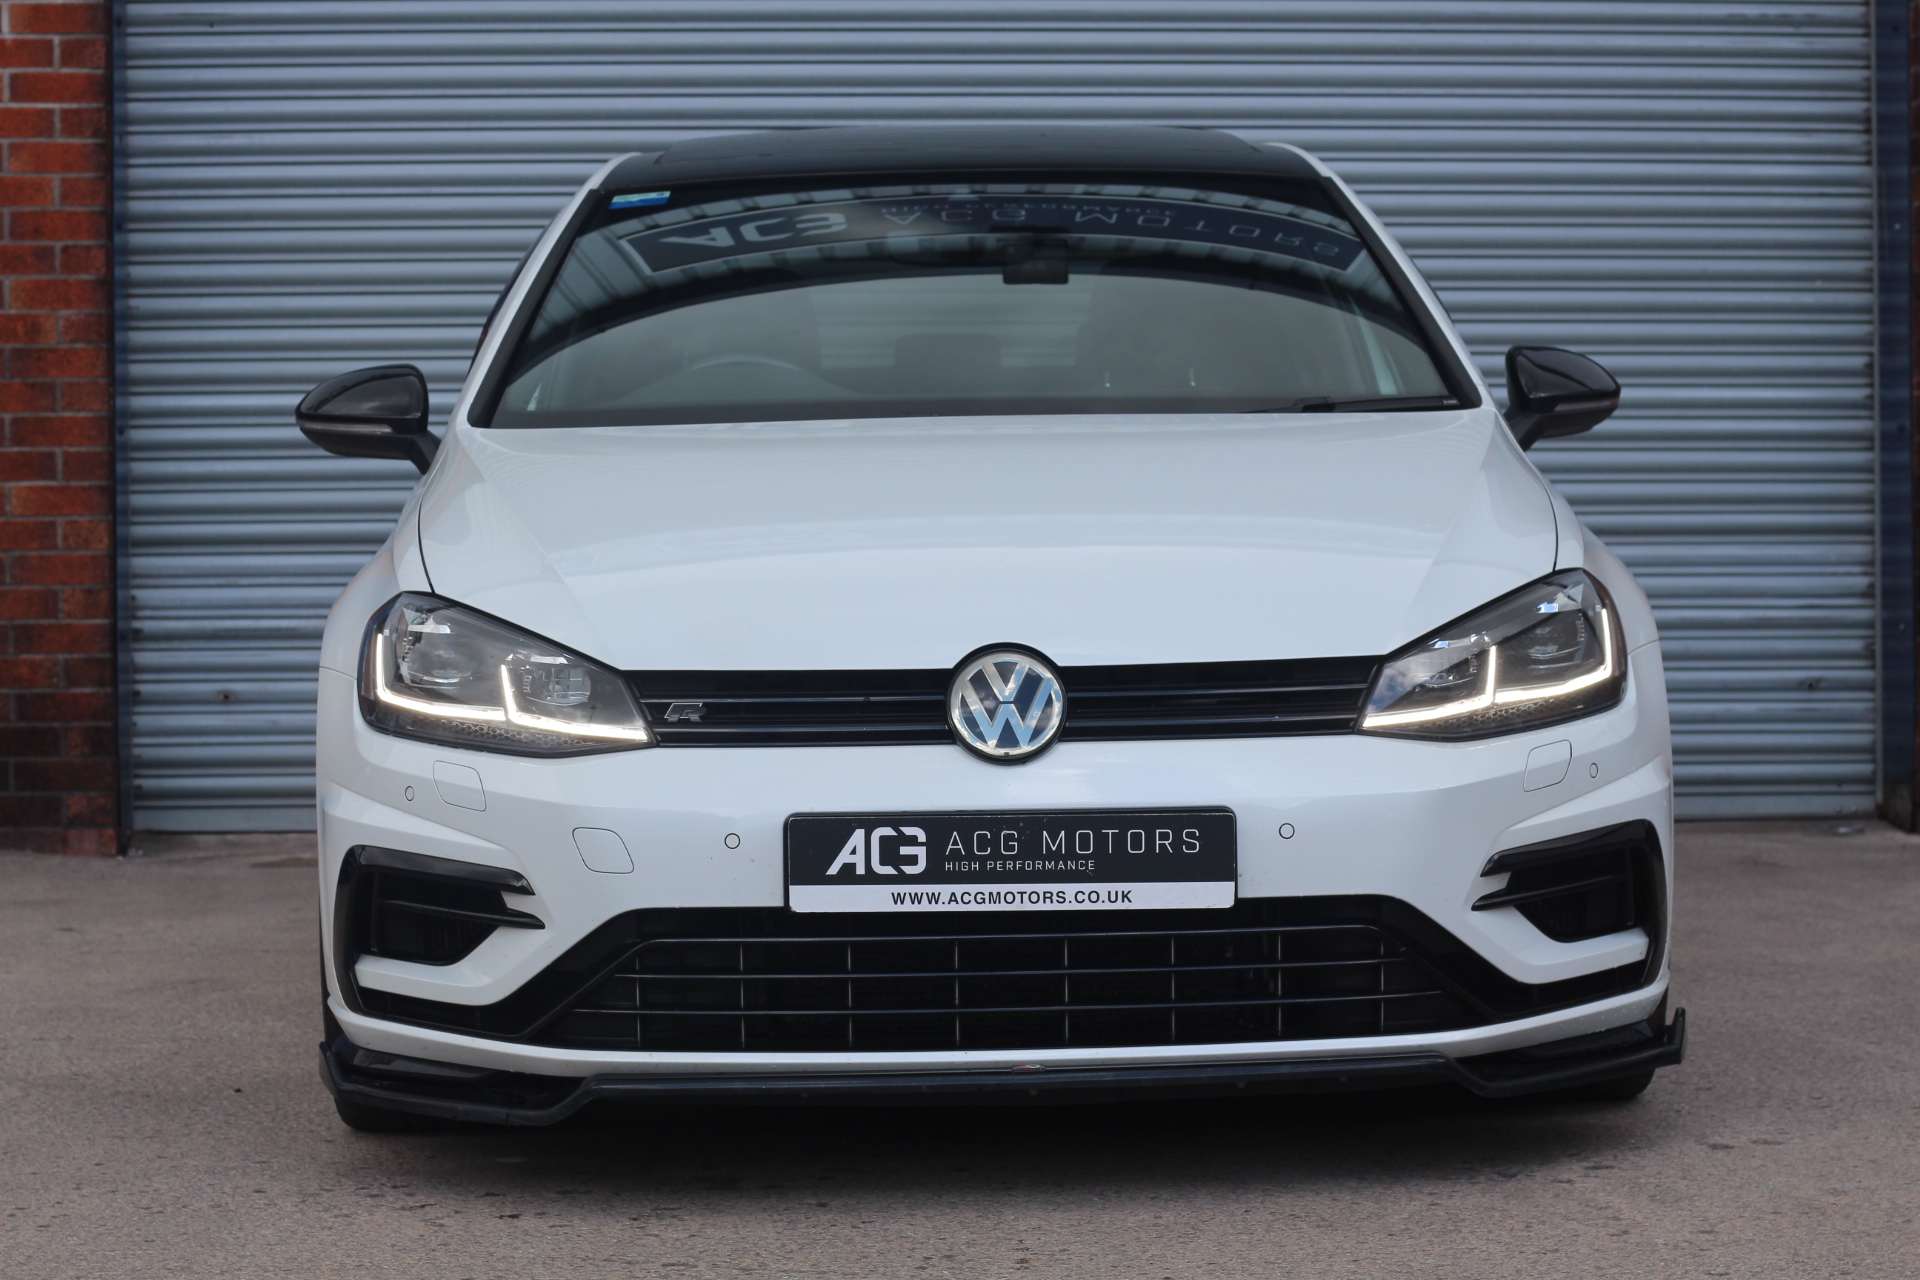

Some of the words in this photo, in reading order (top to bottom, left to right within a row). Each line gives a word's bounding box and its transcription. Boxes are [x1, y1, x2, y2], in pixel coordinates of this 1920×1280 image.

[664, 702, 707, 722] R
[825, 826, 927, 876] ACG
[945, 829, 1019, 855] ACG
[1043, 828, 1200, 854] MOTORS
[945, 861, 980, 872] HIGH
[986, 859, 1096, 871] PERFORMANCE
[891, 889, 1133, 906] WWW.ACGMOTORS.CO.UK
